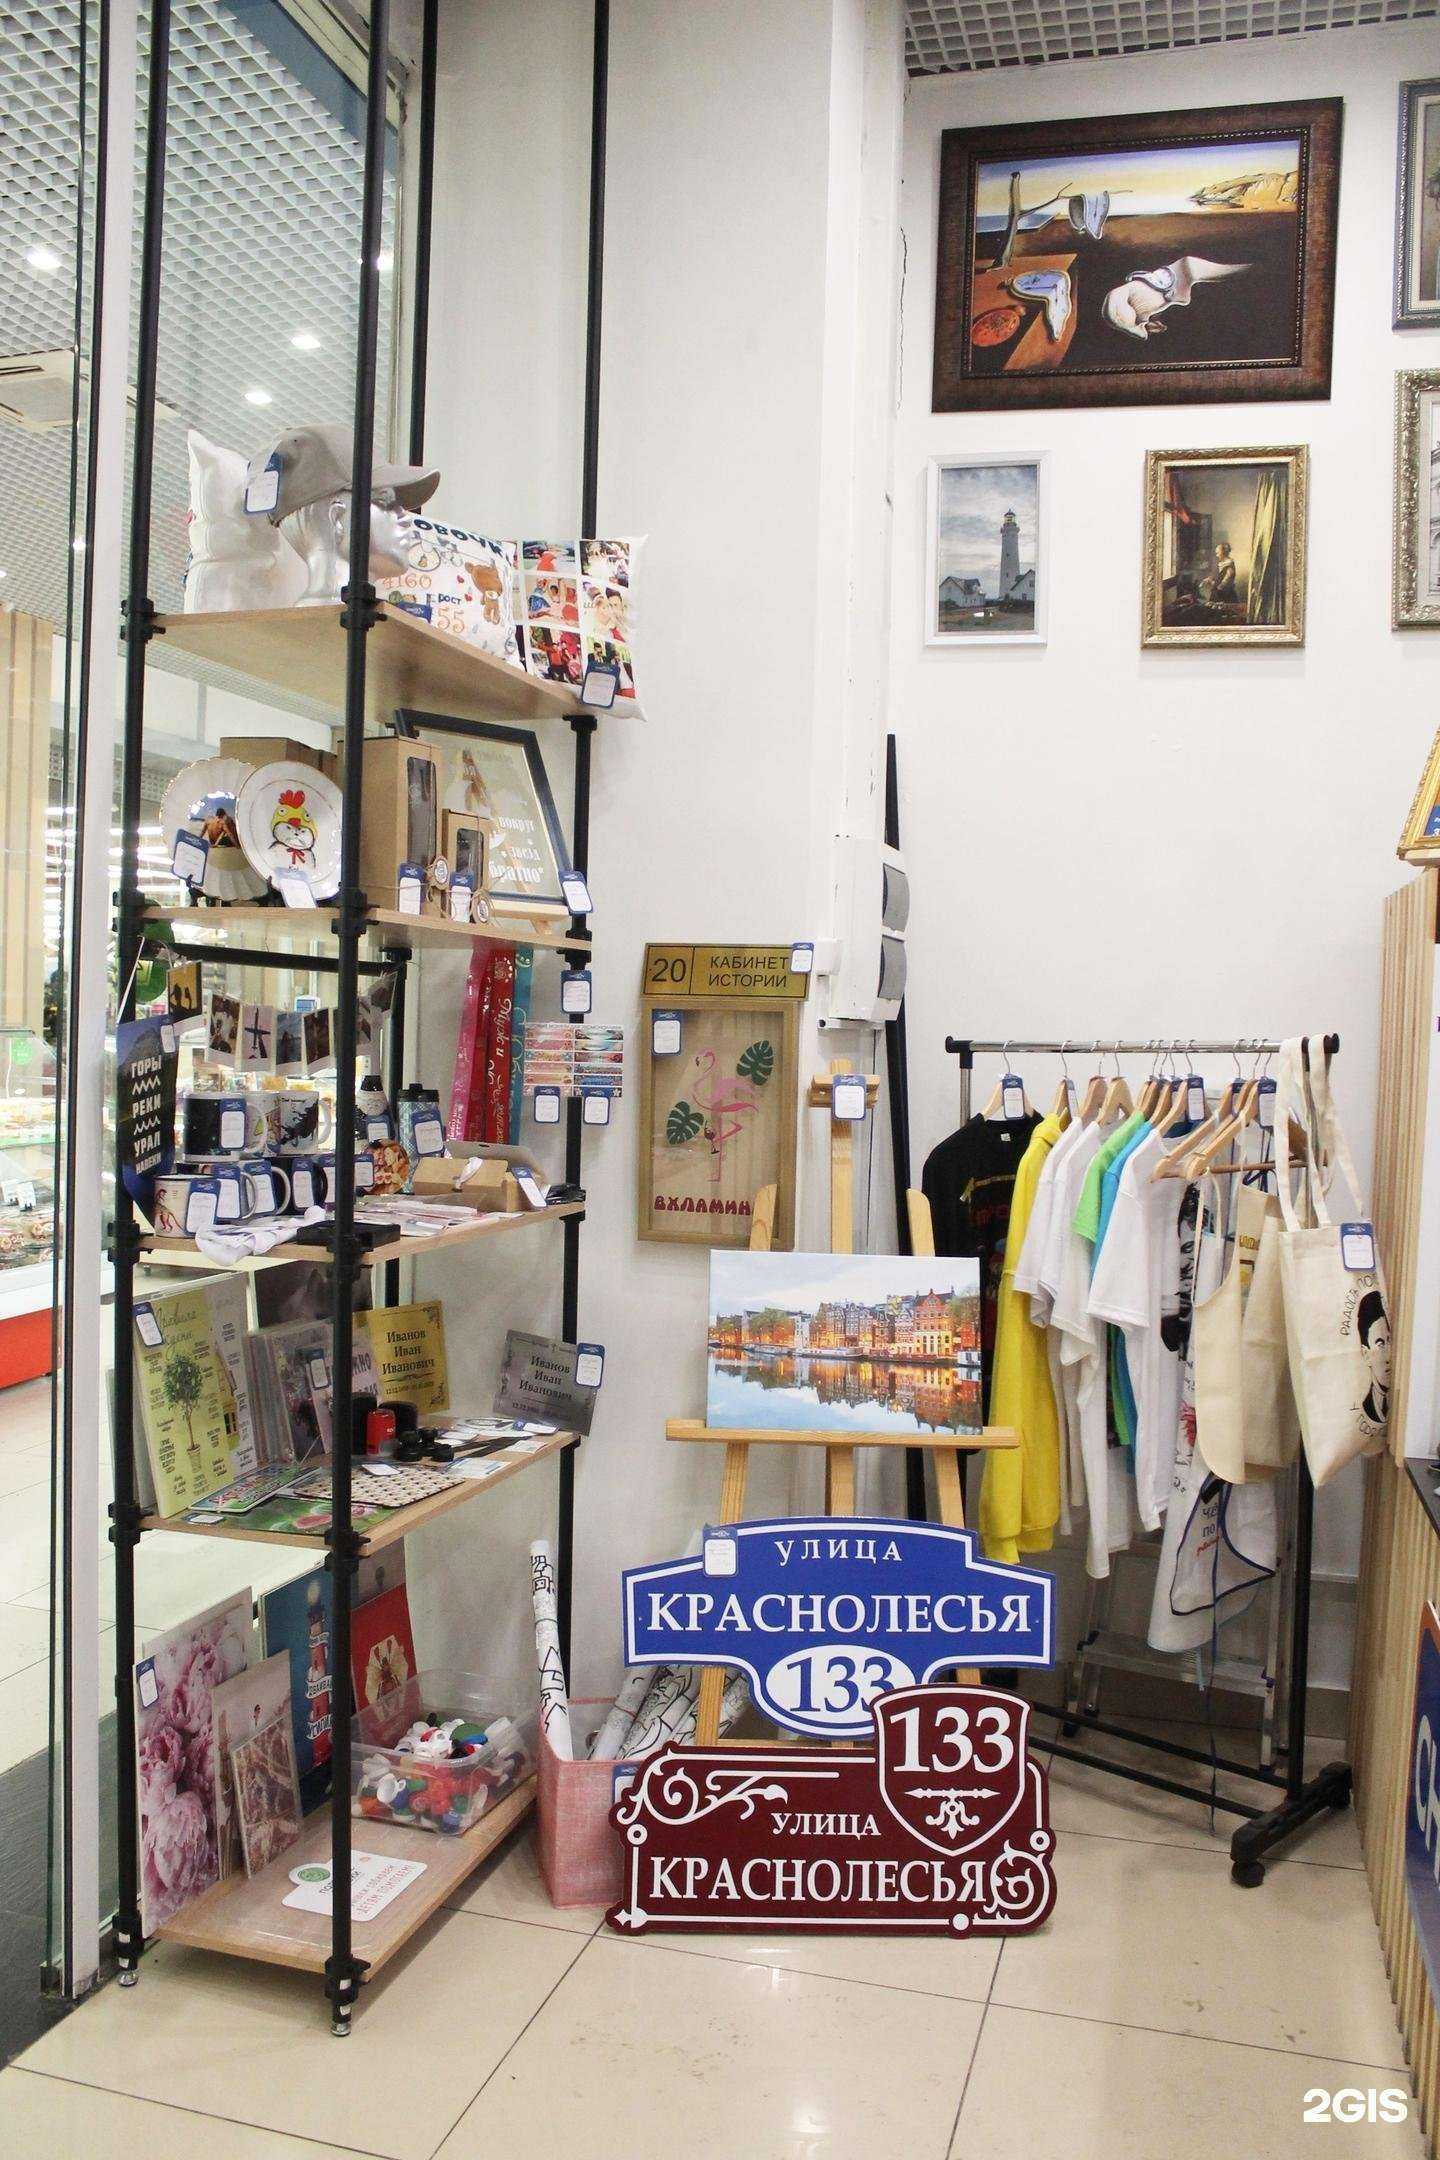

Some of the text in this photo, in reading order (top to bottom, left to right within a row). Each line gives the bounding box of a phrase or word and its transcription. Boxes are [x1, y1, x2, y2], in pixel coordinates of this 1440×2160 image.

[652, 958, 687, 983] 20
[710, 956, 789, 970] КАБИНЕТ
[708, 974, 787, 988] ИСТОРИИ
[131, 1055, 162, 1079] ГОРЫ
[132, 1093, 161, 1119] РЕКИ
[133, 1130, 160, 1158] УРАЛ
[386, 1329, 427, 1343] Иванов
[394, 1344, 423, 1358] Иван
[382, 1358, 436, 1376] Иванович
[530, 1356, 571, 1374] Иванов
[647, 1593, 1031, 1633] КРАСНОЛЕСЬЯ
[786, 1656, 894, 1713] 133
[890, 1706, 1014, 1774] 133
[771, 1813, 882, 1840] УЛИЦА
[650, 1856, 987, 1902] КРАСНОЛЕСЬЯ
